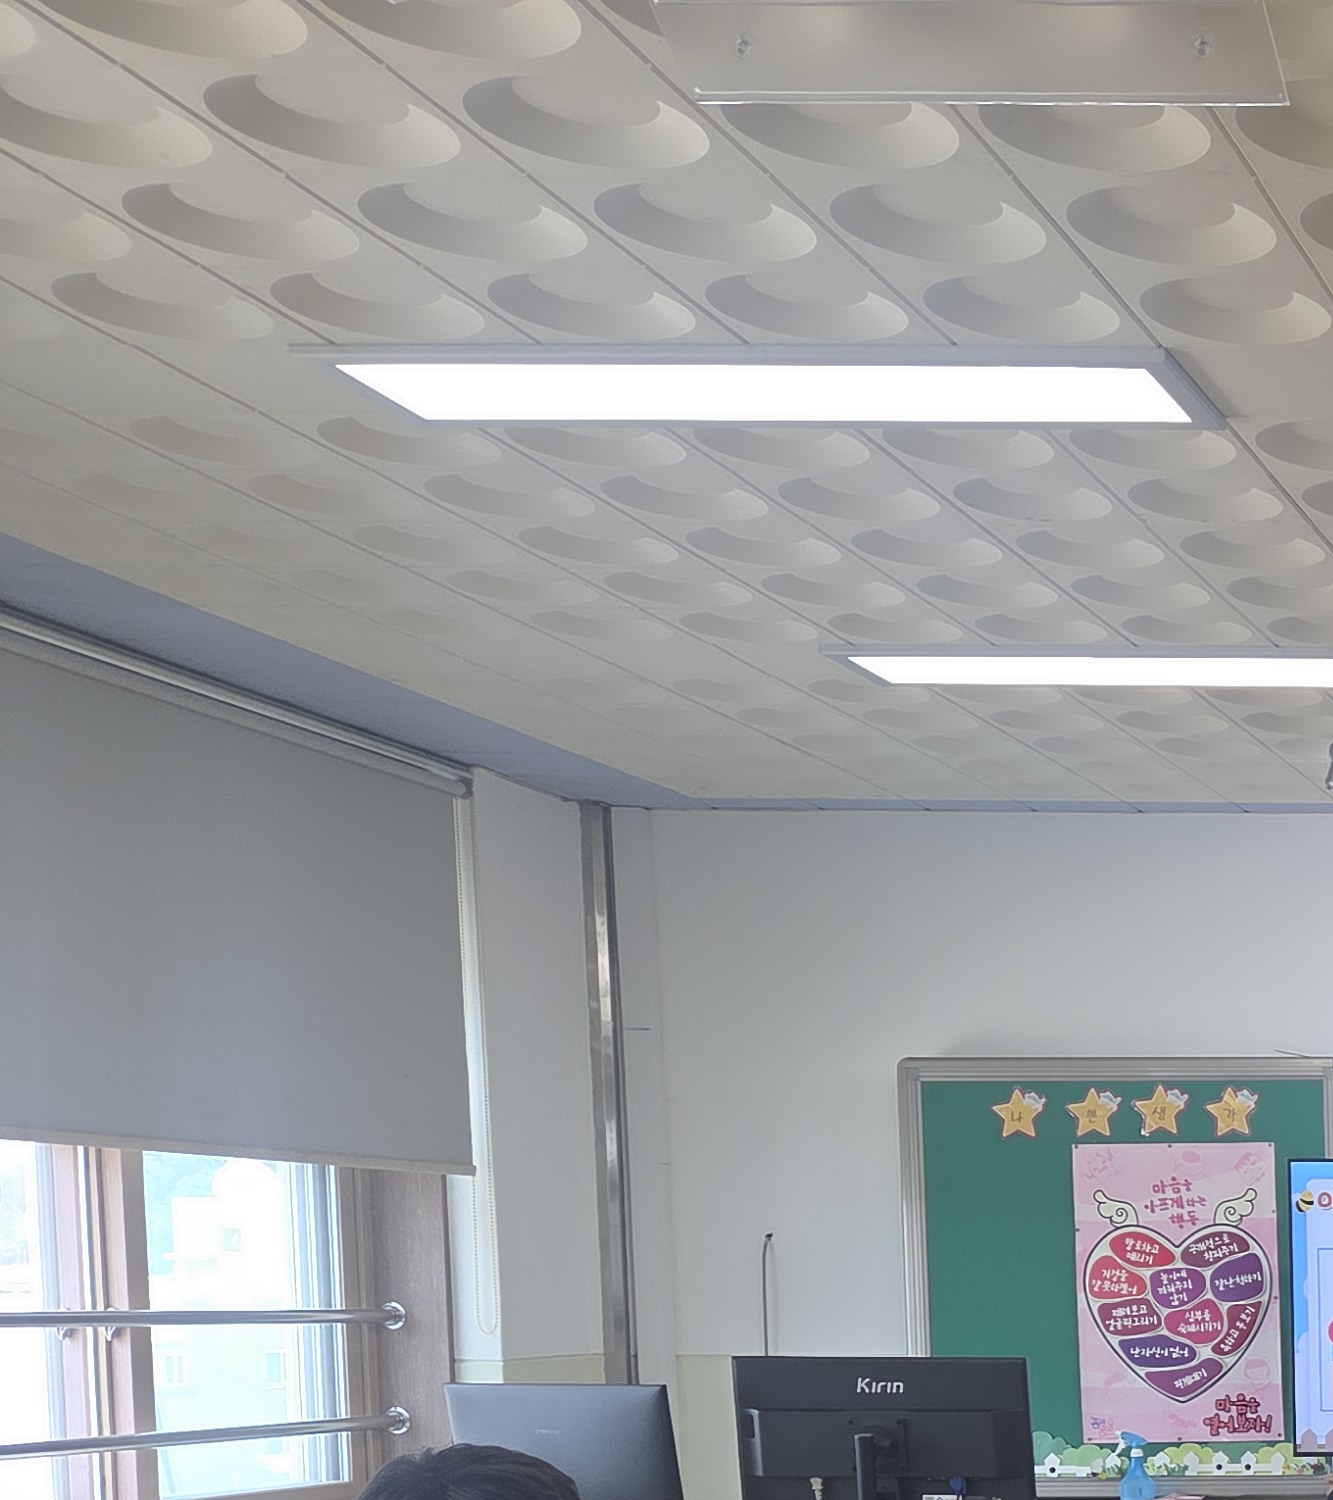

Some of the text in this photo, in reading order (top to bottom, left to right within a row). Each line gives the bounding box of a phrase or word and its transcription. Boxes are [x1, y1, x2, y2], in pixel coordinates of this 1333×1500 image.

[1152, 1176, 1193, 1195] 마음을
[1144, 1196, 1185, 1214] 아프게
[1169, 1210, 1200, 1229] 행동
[856, 1377, 904, 1394] Kirin
[1214, 1393, 1261, 1415] 마음을
